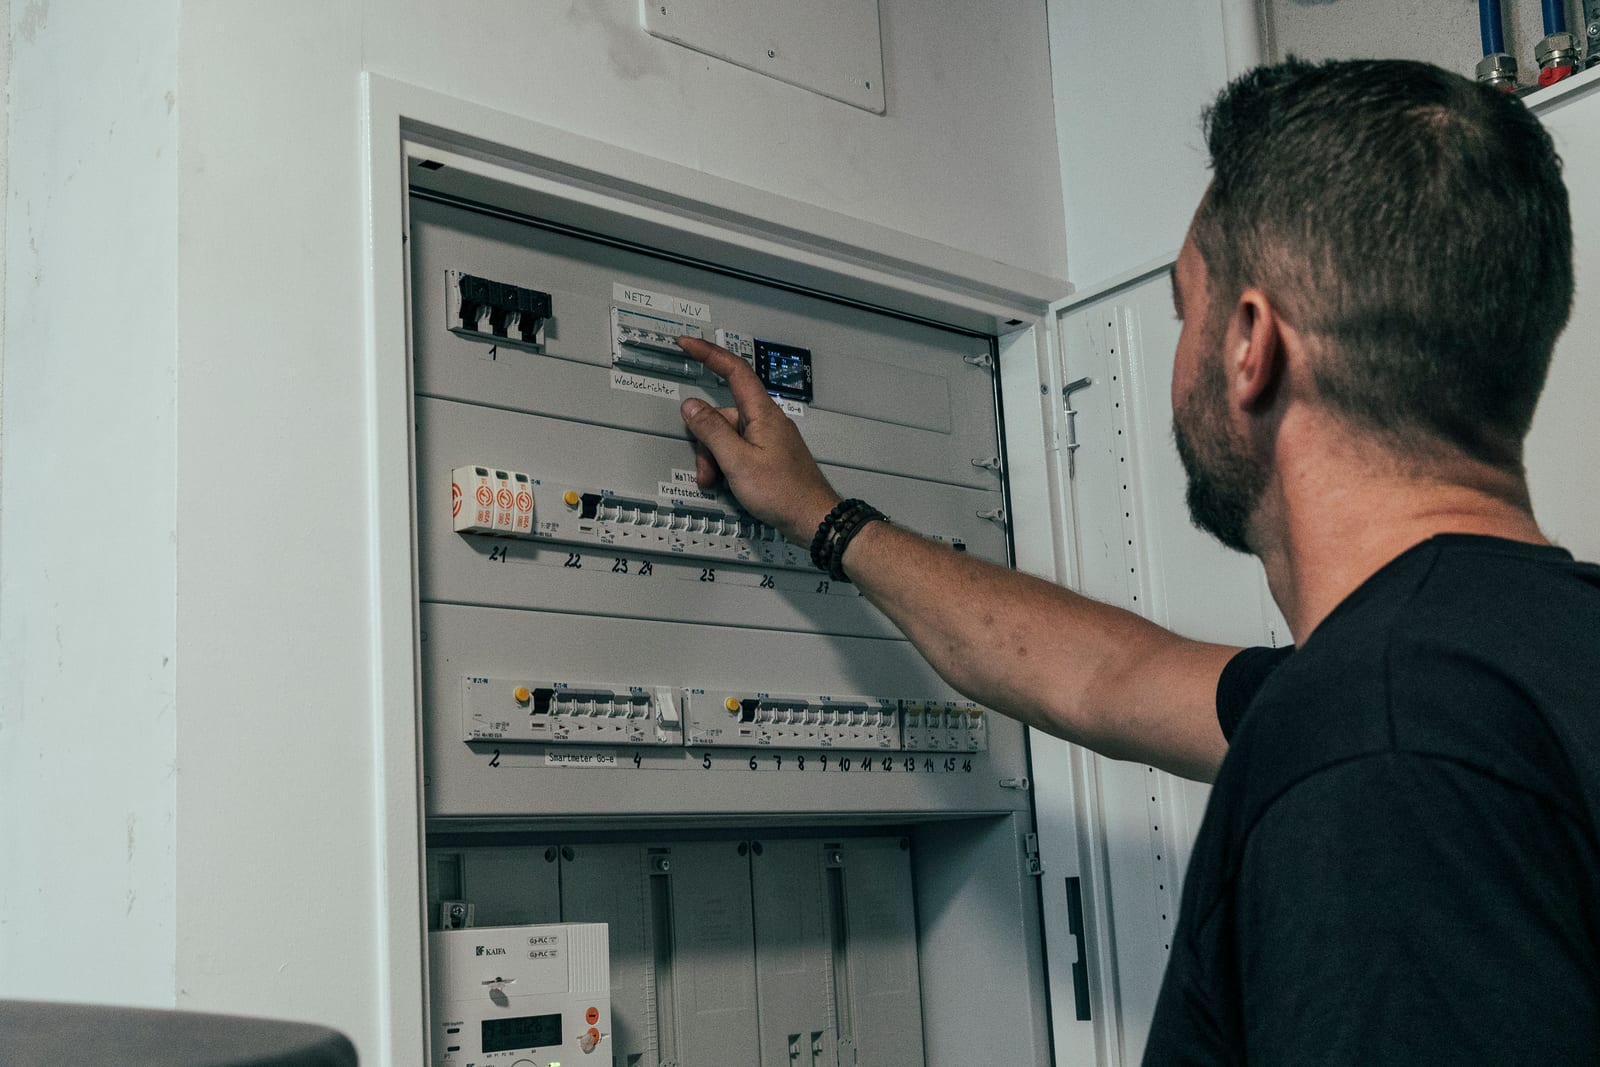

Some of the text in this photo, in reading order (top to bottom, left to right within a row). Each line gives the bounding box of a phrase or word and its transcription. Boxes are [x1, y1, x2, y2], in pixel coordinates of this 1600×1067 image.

[624, 290, 653, 306] NETZ
[679, 303, 702, 316] WLV
[488, 345, 497, 361] 1
[614, 375, 675, 396] Wechselrichter
[488, 546, 506, 563] 21
[564, 553, 582, 569] 22
[612, 558, 628, 574] 23
[638, 560, 652, 576] 24
[700, 568, 715, 582] 25
[760, 574, 775, 589] 26
[816, 581, 830, 595] 27
[488, 750, 500, 768] 2
[549, 753, 614, 763] Smartmeter Go-e
[633, 752, 642, 769] 4
[702, 754, 712, 769] 5
[749, 756, 758, 770] 6
[773, 756, 782, 770] 7
[797, 756, 805, 771] 8
[820, 756, 827, 771] 9
[838, 757, 850, 771] 10
[861, 757, 872, 771] 11
[881, 757, 893, 771] 12
[903, 758, 915, 773] 13
[924, 758, 934, 773] 14
[943, 757, 956, 773] 15
[962, 759, 972, 773] 16
[486, 948, 506, 956] KAIFA
